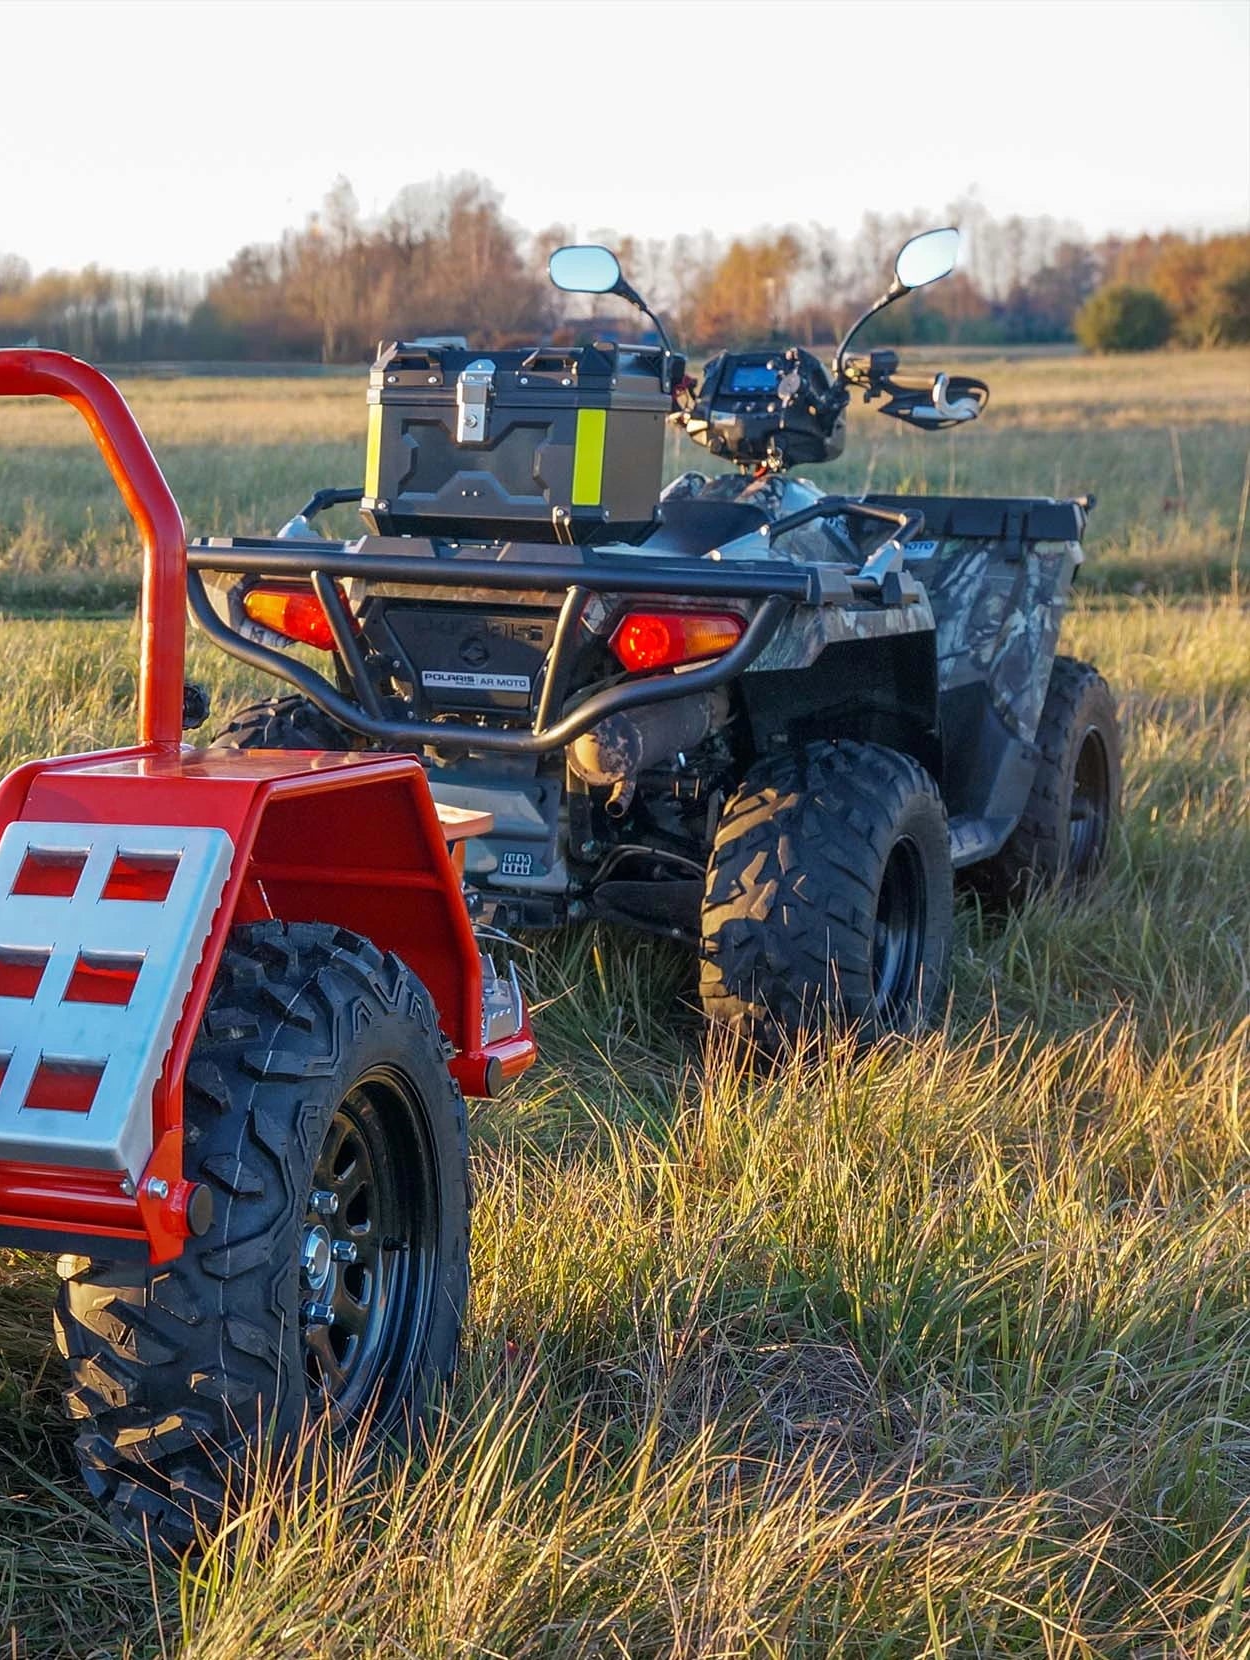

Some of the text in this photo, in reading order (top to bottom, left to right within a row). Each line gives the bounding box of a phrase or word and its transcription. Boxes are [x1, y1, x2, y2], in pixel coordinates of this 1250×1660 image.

[424, 673, 475, 683] POLARIS
[480, 677, 494, 686] AR
[496, 678, 527, 688] MOTO
